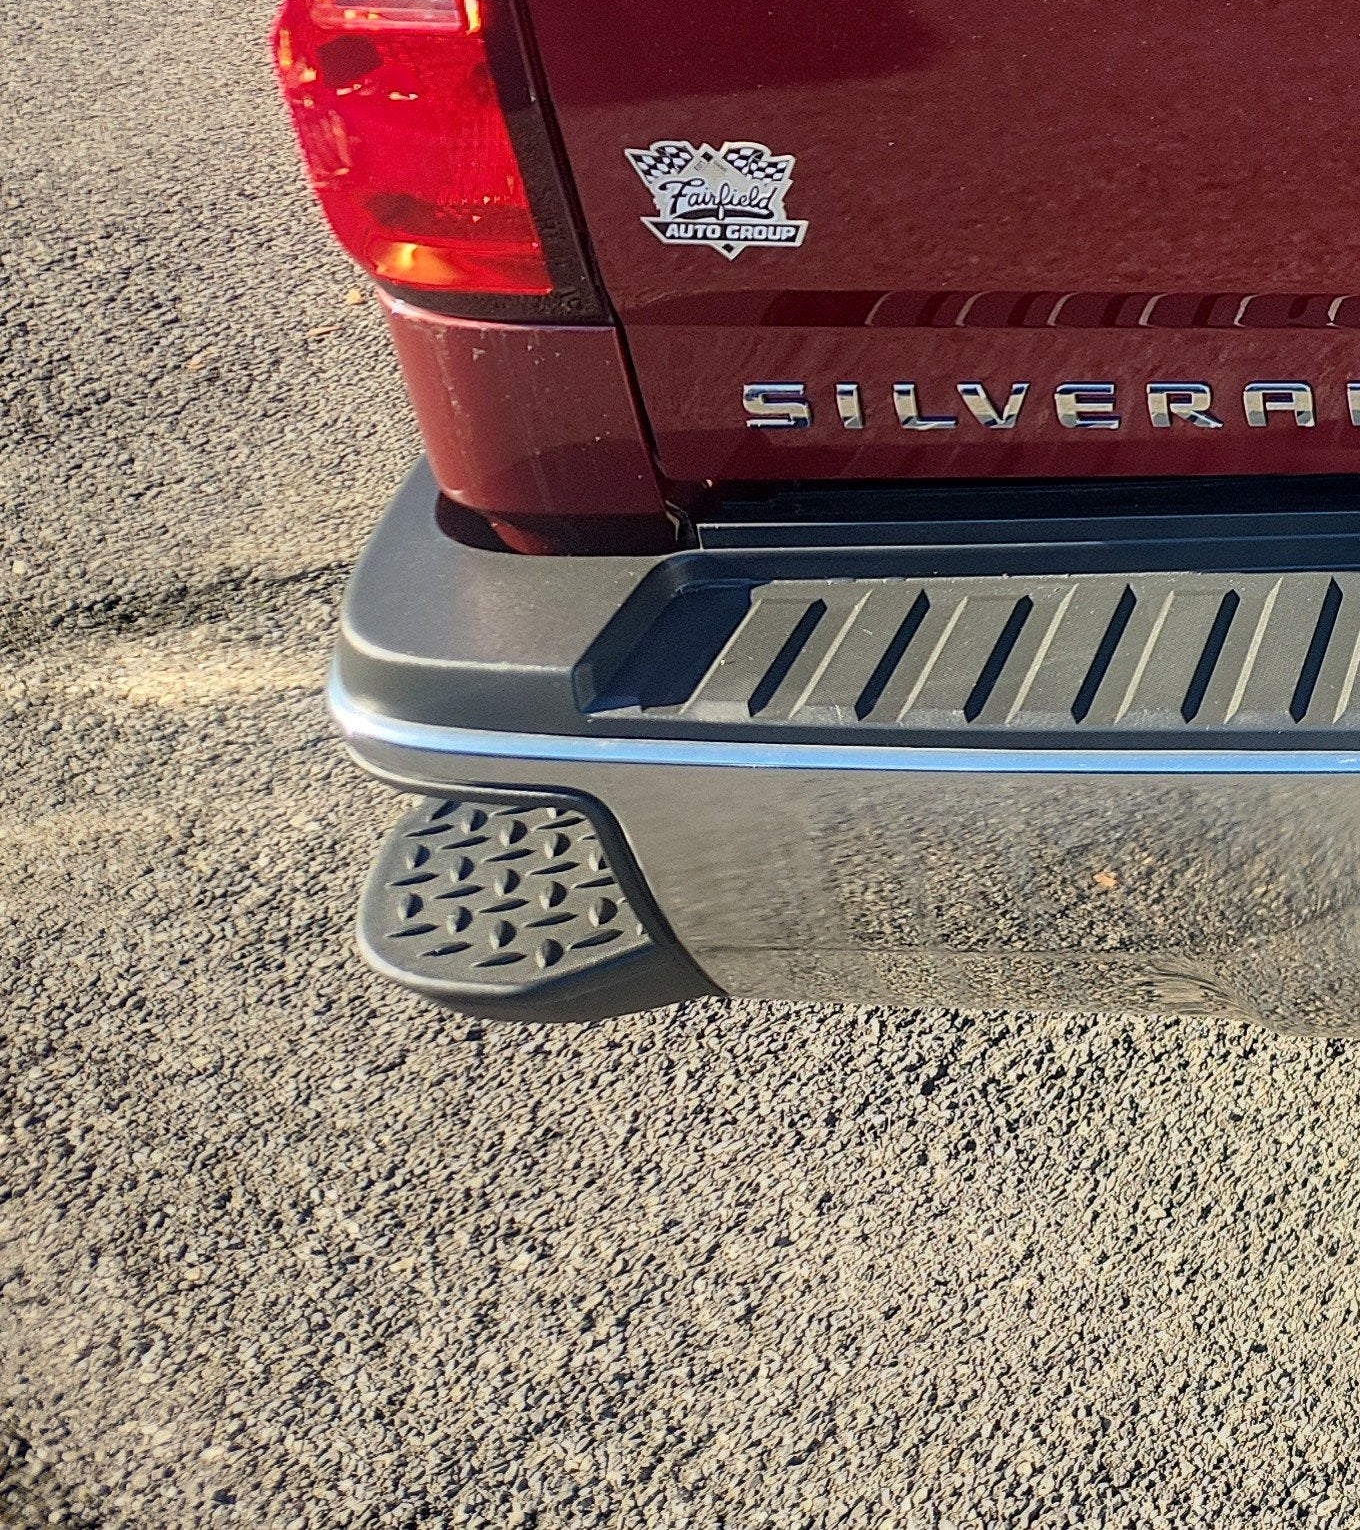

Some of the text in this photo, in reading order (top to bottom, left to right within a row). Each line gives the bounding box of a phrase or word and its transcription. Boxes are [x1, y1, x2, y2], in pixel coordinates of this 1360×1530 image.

[658, 177, 778, 216] Fairfield
[665, 223, 796, 240] AUTO GROUP
